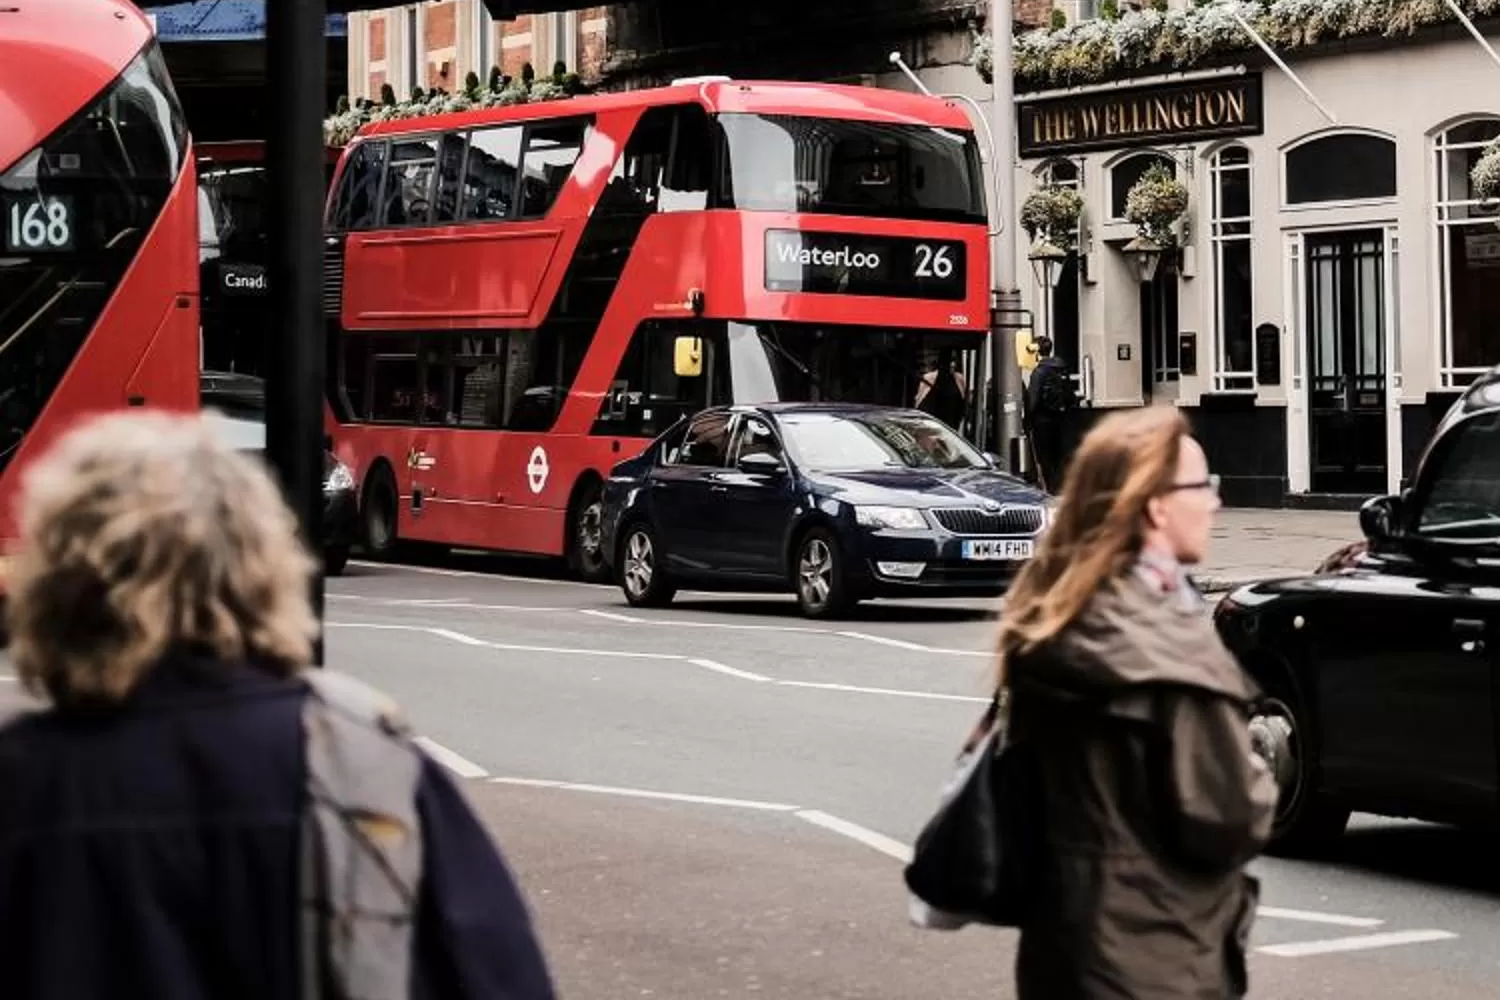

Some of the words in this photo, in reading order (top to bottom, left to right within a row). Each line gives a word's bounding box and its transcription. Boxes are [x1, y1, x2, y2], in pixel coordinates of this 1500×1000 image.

[1033, 109, 1075, 143] THE
[1081, 88, 1246, 137] WELLINGTON
[11, 201, 69, 247] 168
[775, 243, 881, 269] Waterloo
[914, 245, 953, 278] 26
